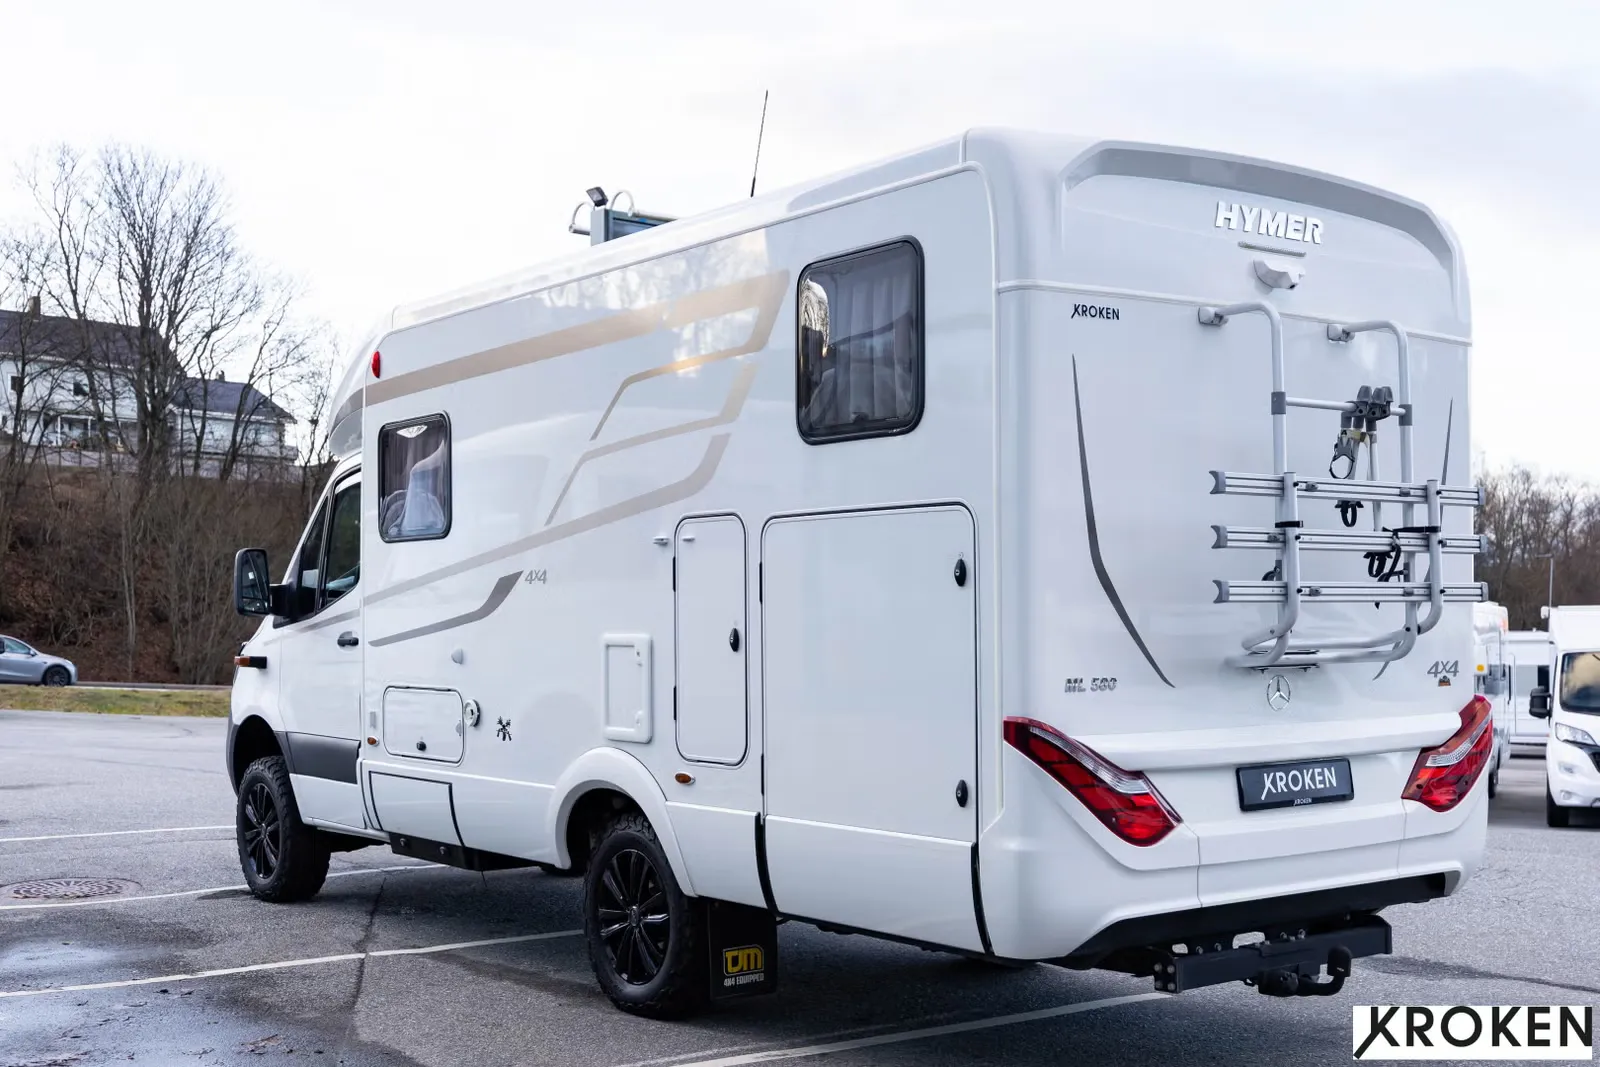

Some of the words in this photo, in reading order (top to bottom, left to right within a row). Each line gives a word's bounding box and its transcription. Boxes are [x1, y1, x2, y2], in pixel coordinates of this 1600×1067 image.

[1215, 201, 1324, 244] HYMER
[1071, 304, 1119, 320] KROKEN
[1065, 678, 1086, 692] ML
[1261, 766, 1337, 800] KROKEN
[736, 973, 764, 985] EQUIPPED
